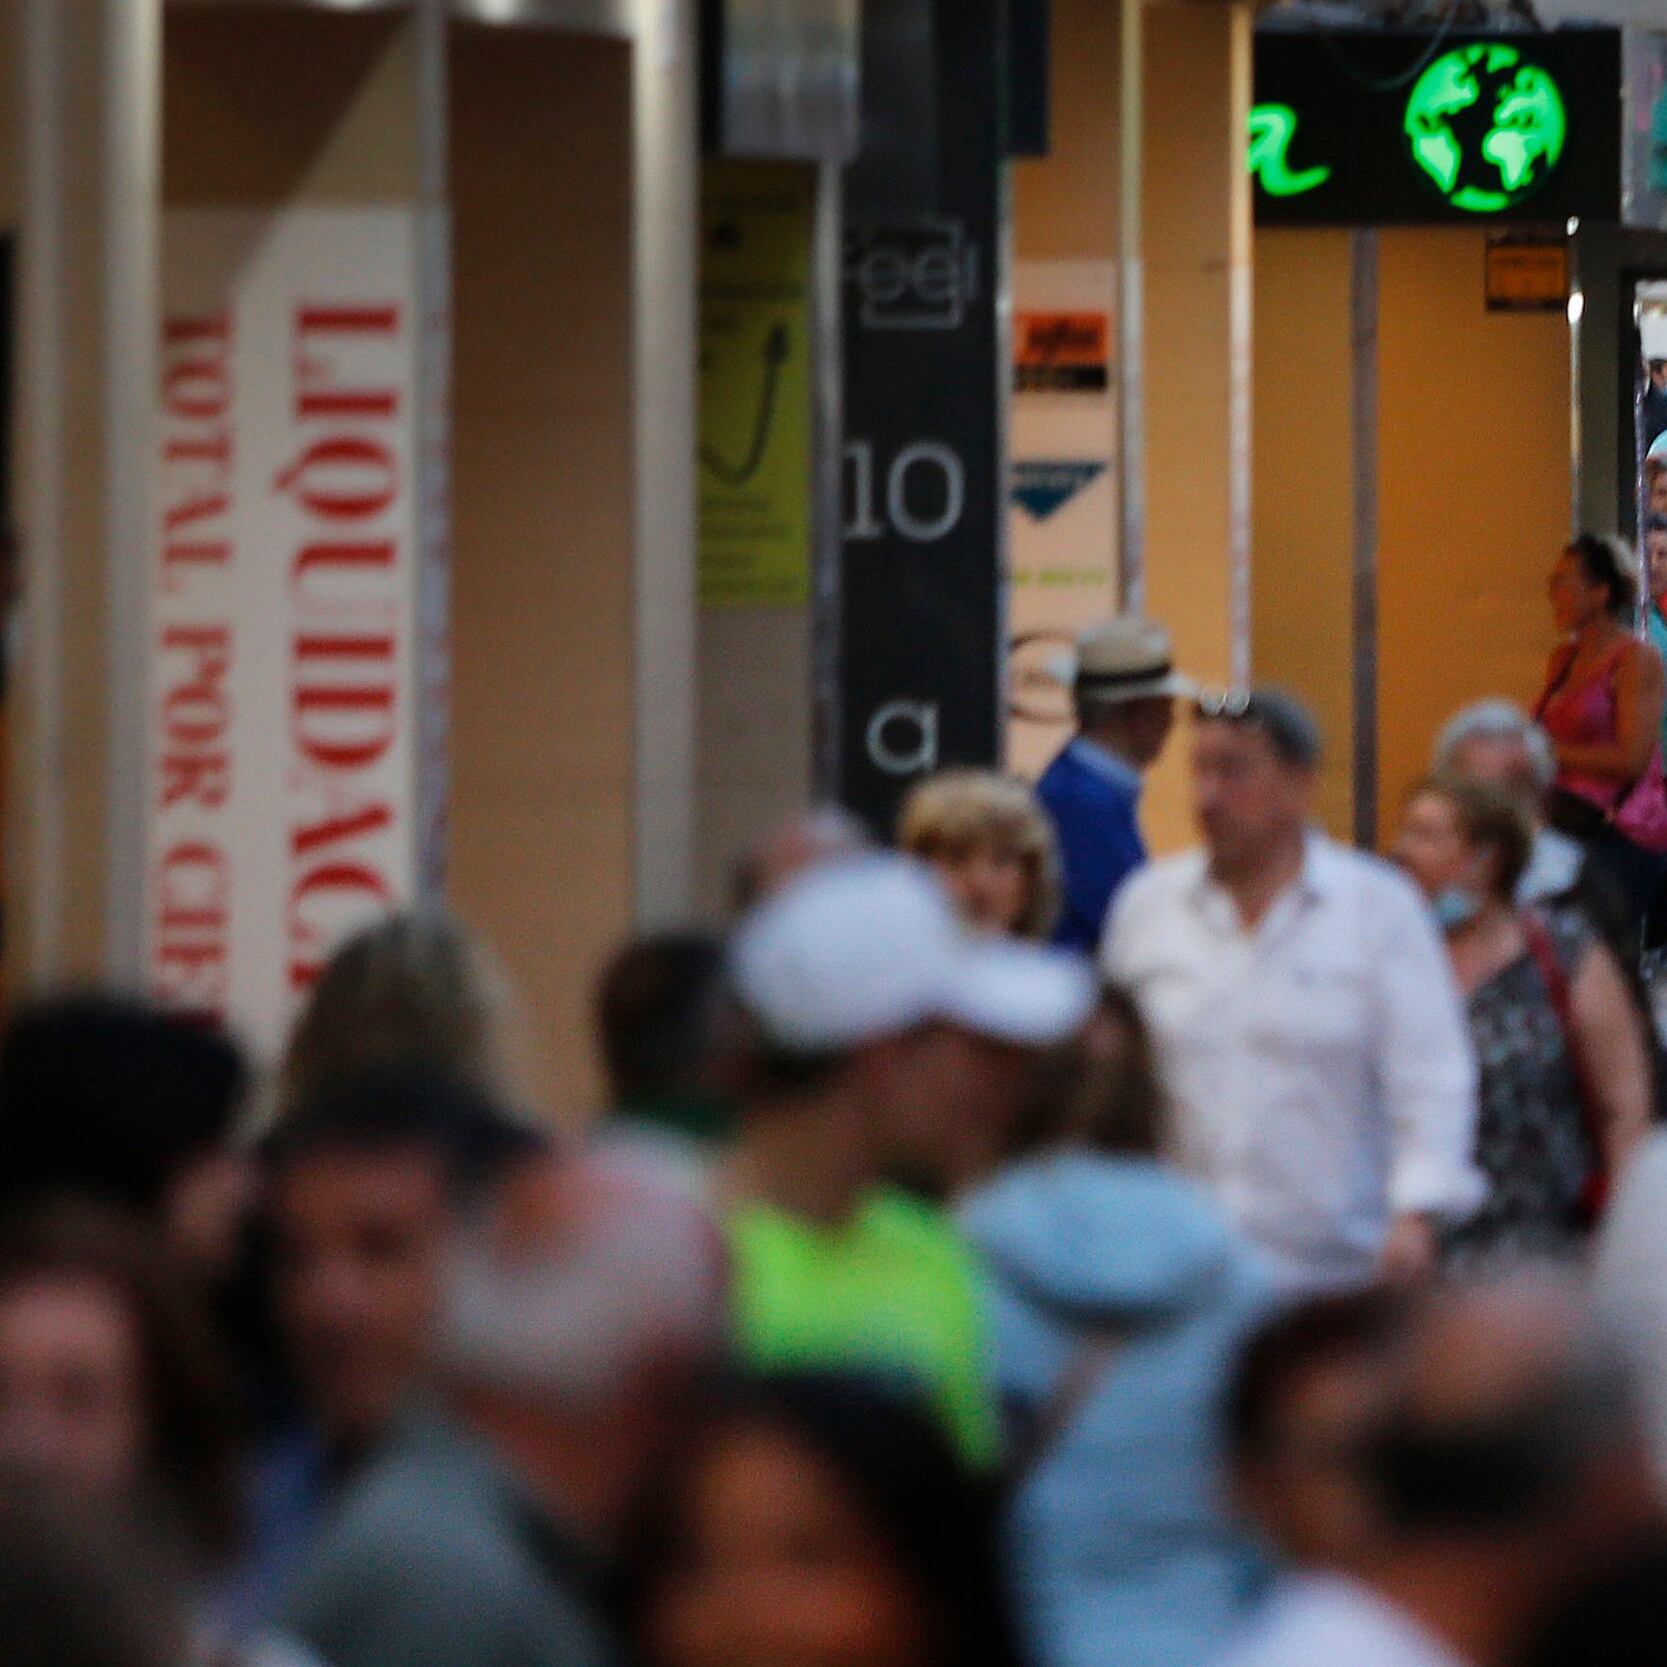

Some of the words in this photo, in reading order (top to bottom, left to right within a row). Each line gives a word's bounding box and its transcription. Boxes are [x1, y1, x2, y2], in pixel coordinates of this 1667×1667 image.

[160, 306, 234, 593] TOTAL
[160, 626, 234, 809] POR
[274, 300, 399, 992] LIQUIDAC
